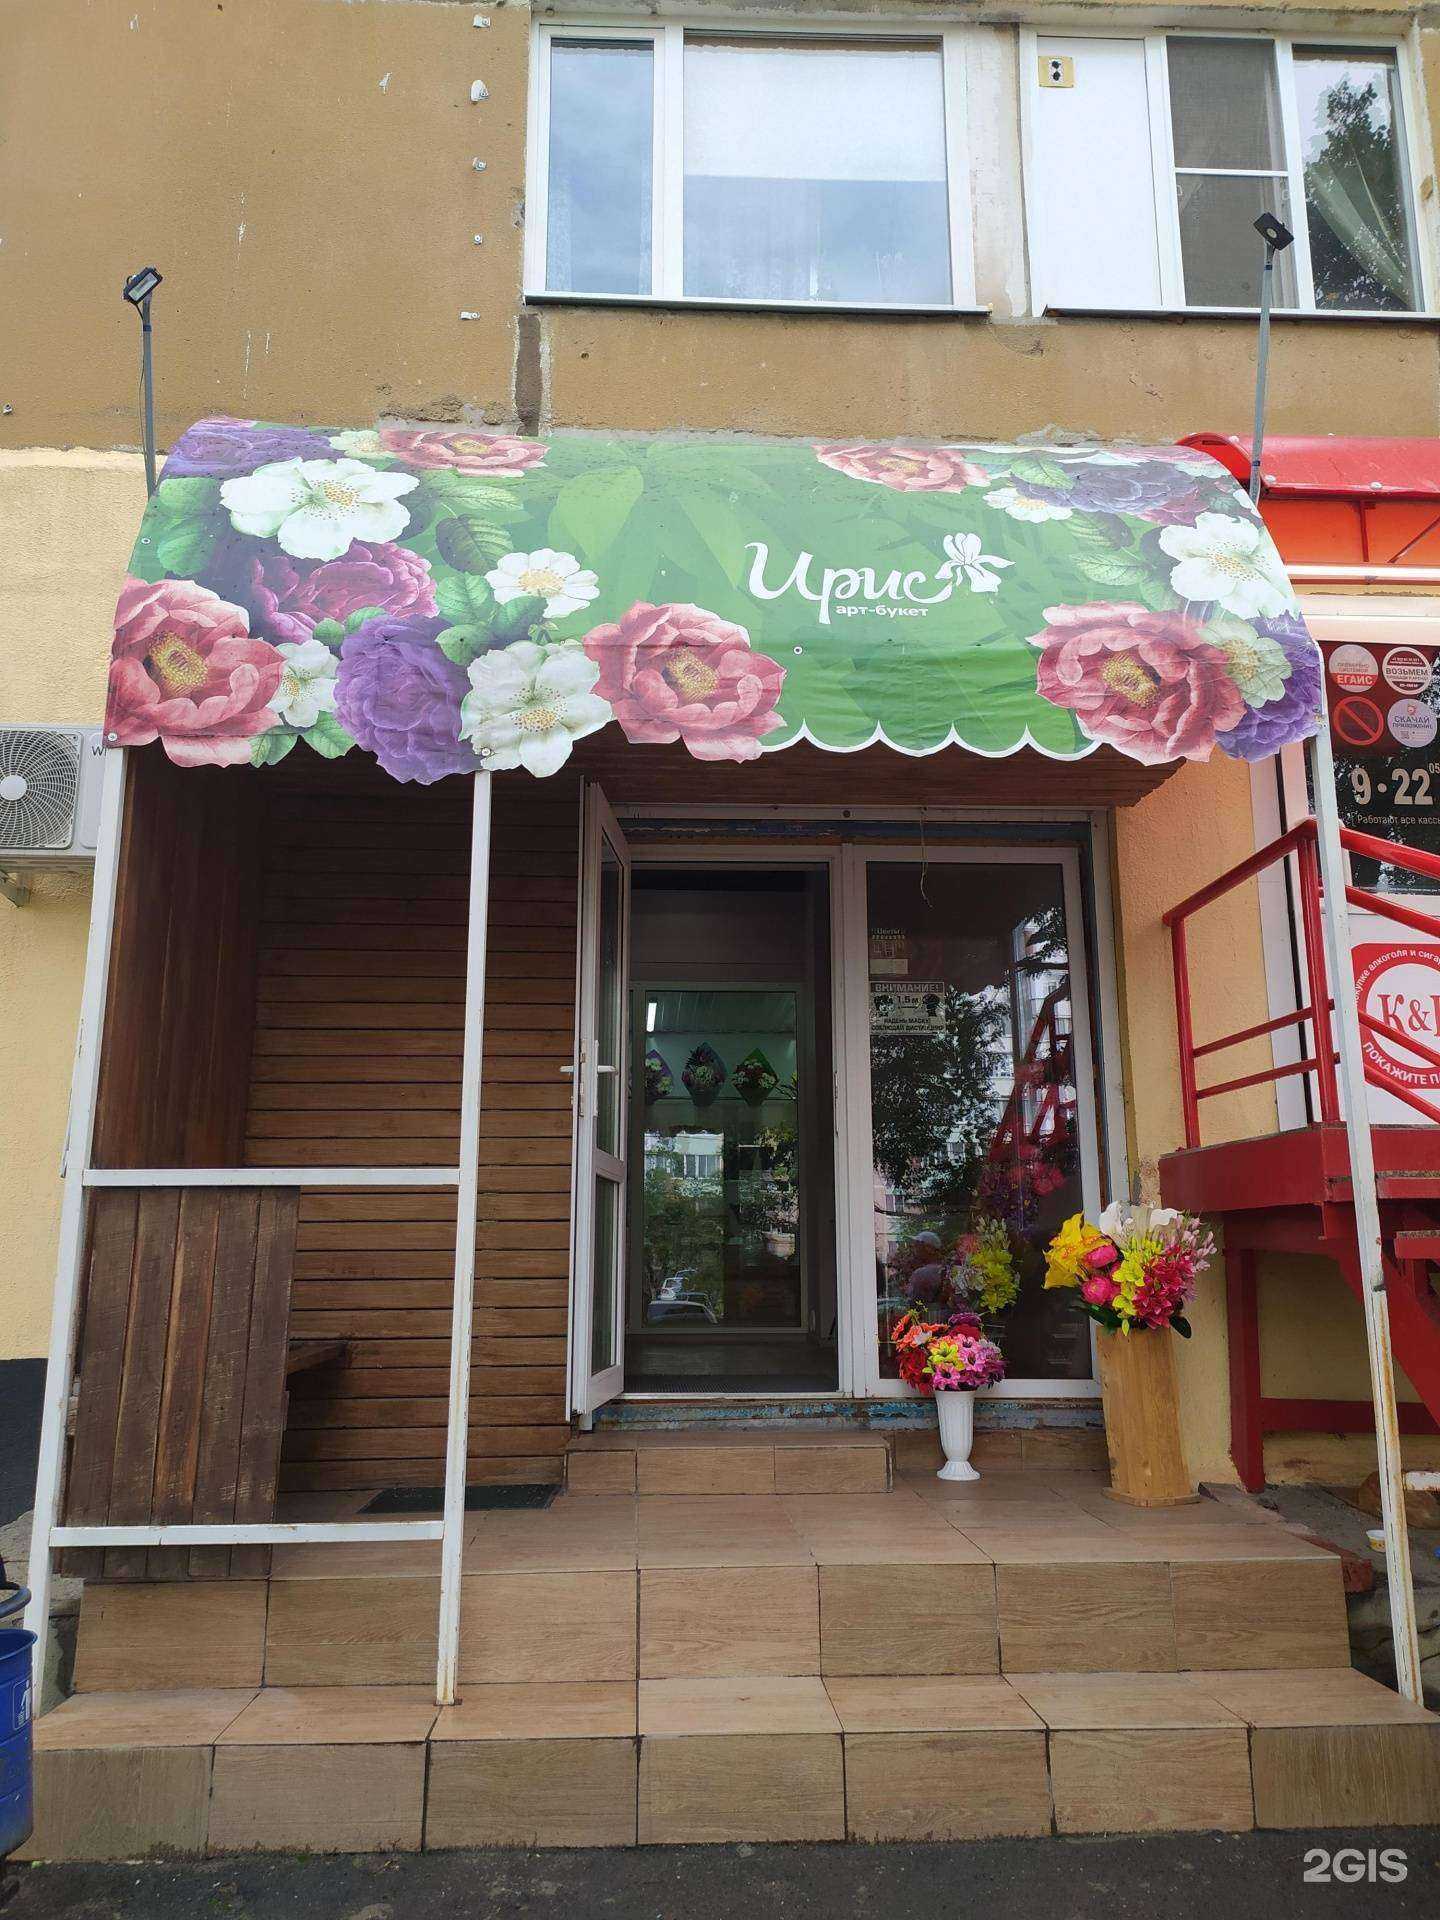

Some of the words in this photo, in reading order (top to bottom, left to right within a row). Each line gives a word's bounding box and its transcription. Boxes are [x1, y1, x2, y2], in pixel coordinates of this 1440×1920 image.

[744, 542, 952, 625] Ирис
[835, 604, 929, 618] арт-букет
[1385, 667, 1429, 676] ВОЗЬМЕМ
[1336, 674, 1373, 685] ЕГАИС
[1394, 715, 1430, 725] СКАЧАЙ
[1357, 815, 1398, 825] Работают
[1400, 817, 1416, 825] все
[1368, 949, 1408, 971] алкоголя
[1409, 949, 1416, 957] и
[875, 983, 939, 992] ВНИМАНИЕ!
[1363, 1041, 1428, 1085] ПОКАЖИТЕ
